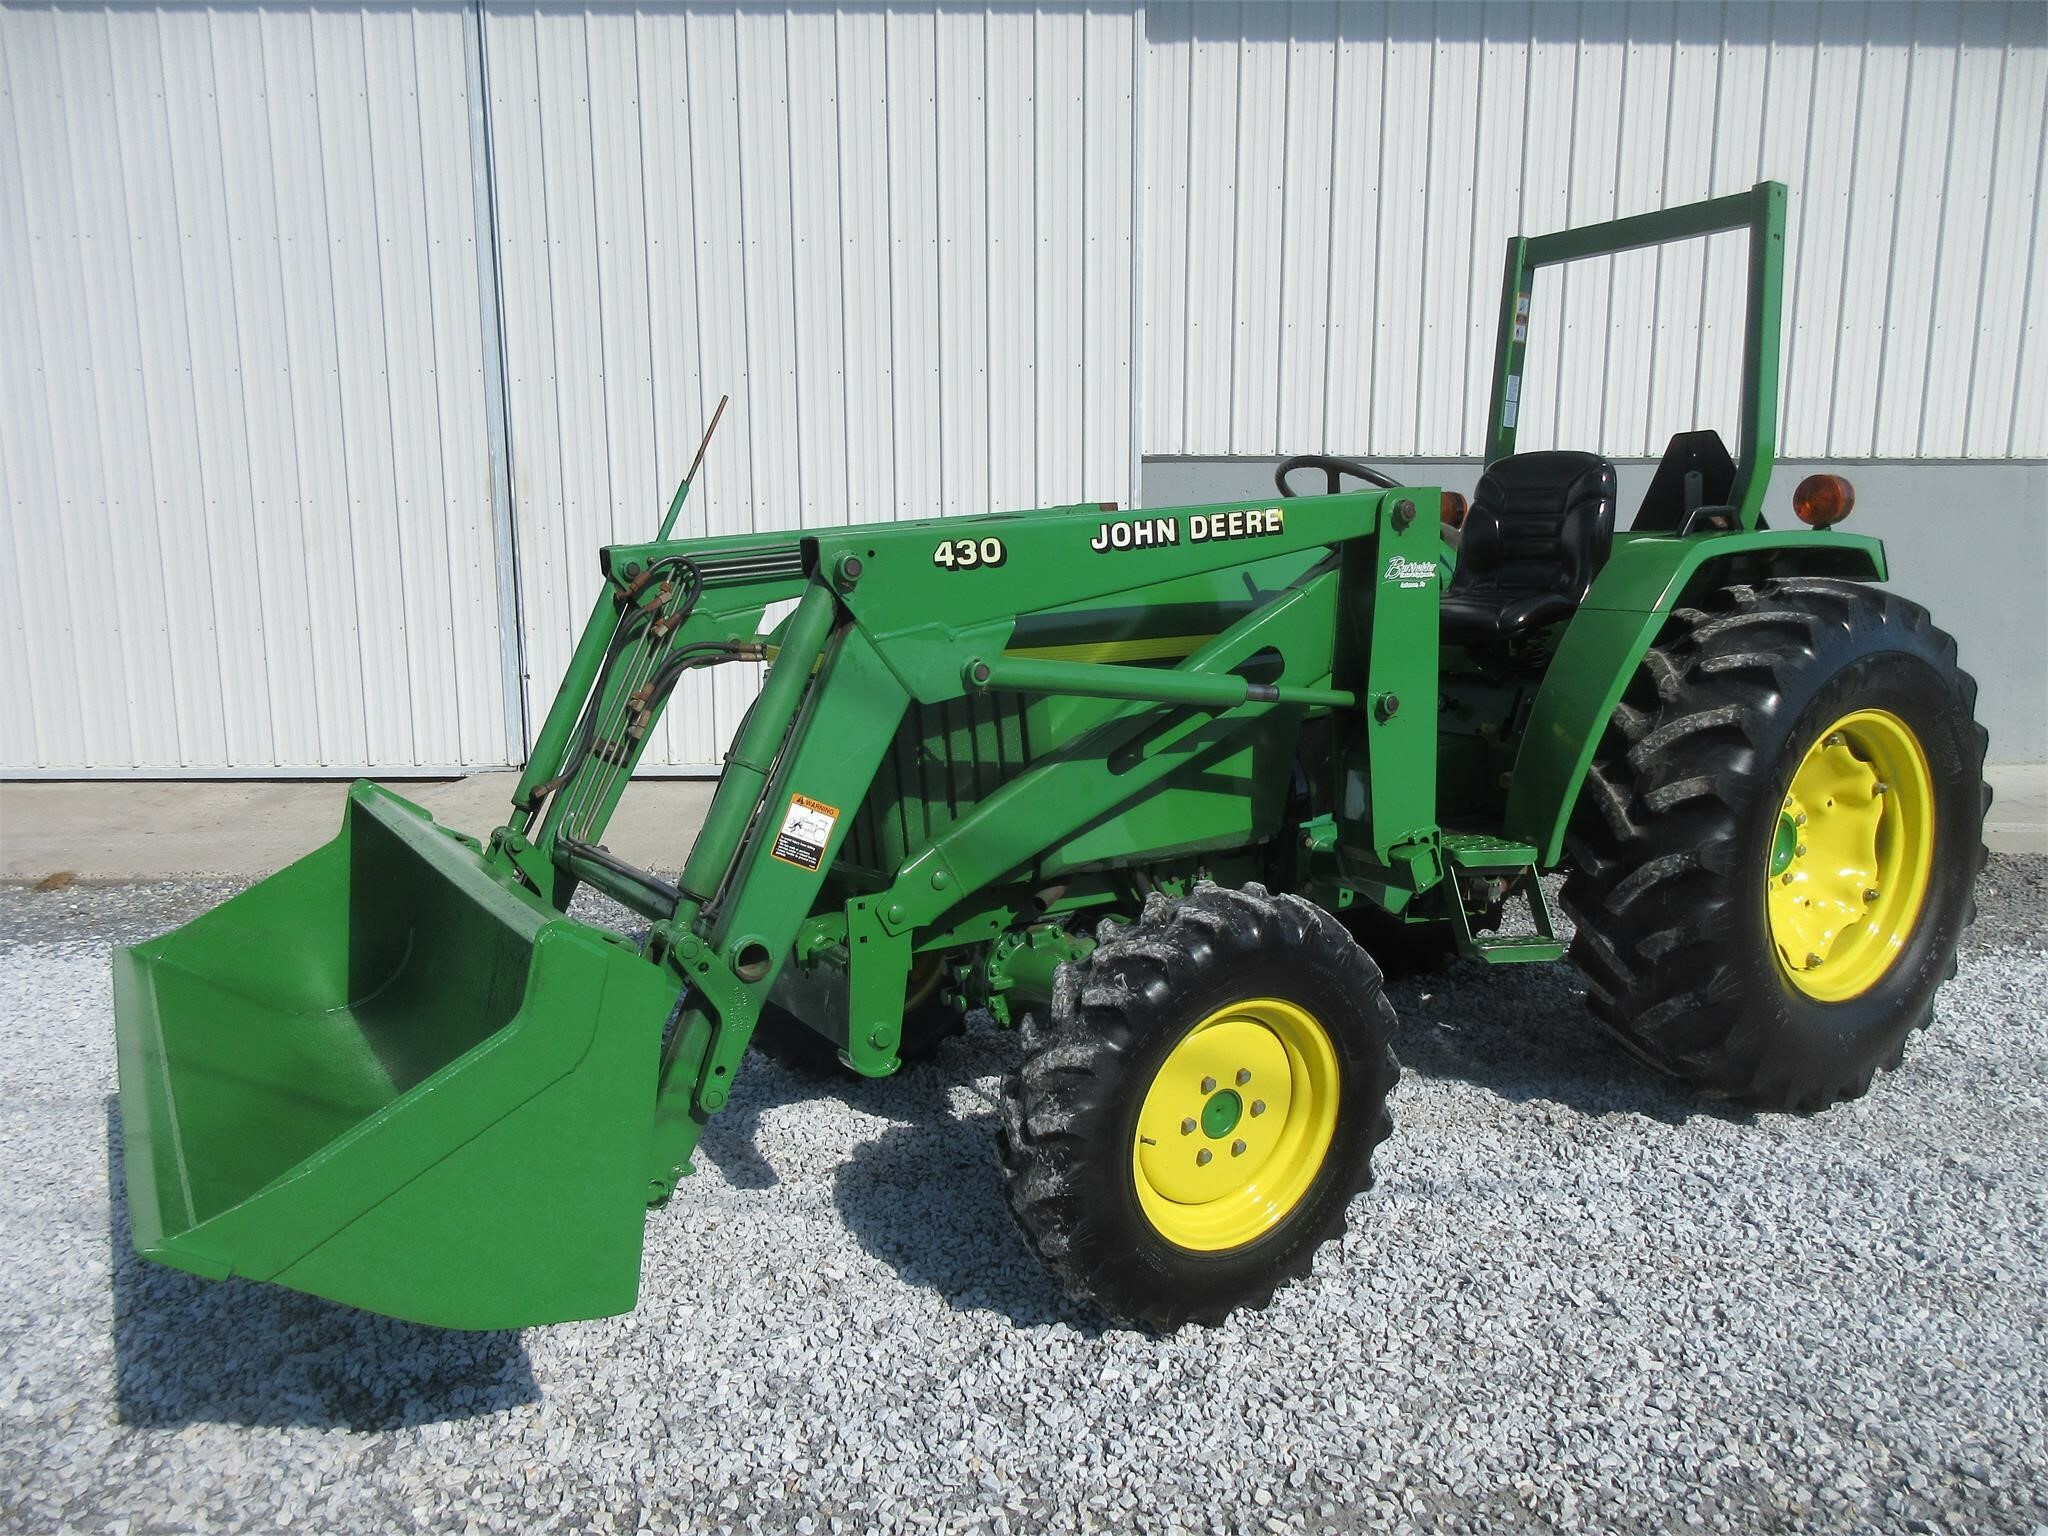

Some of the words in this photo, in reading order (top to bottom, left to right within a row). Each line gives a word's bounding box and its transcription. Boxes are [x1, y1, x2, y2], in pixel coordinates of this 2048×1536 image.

[1091, 517, 1179, 552] JOHN
[1189, 508, 1283, 543] DEERE
[933, 537, 1005, 570] 430
[805, 799, 834, 816] WARNING
